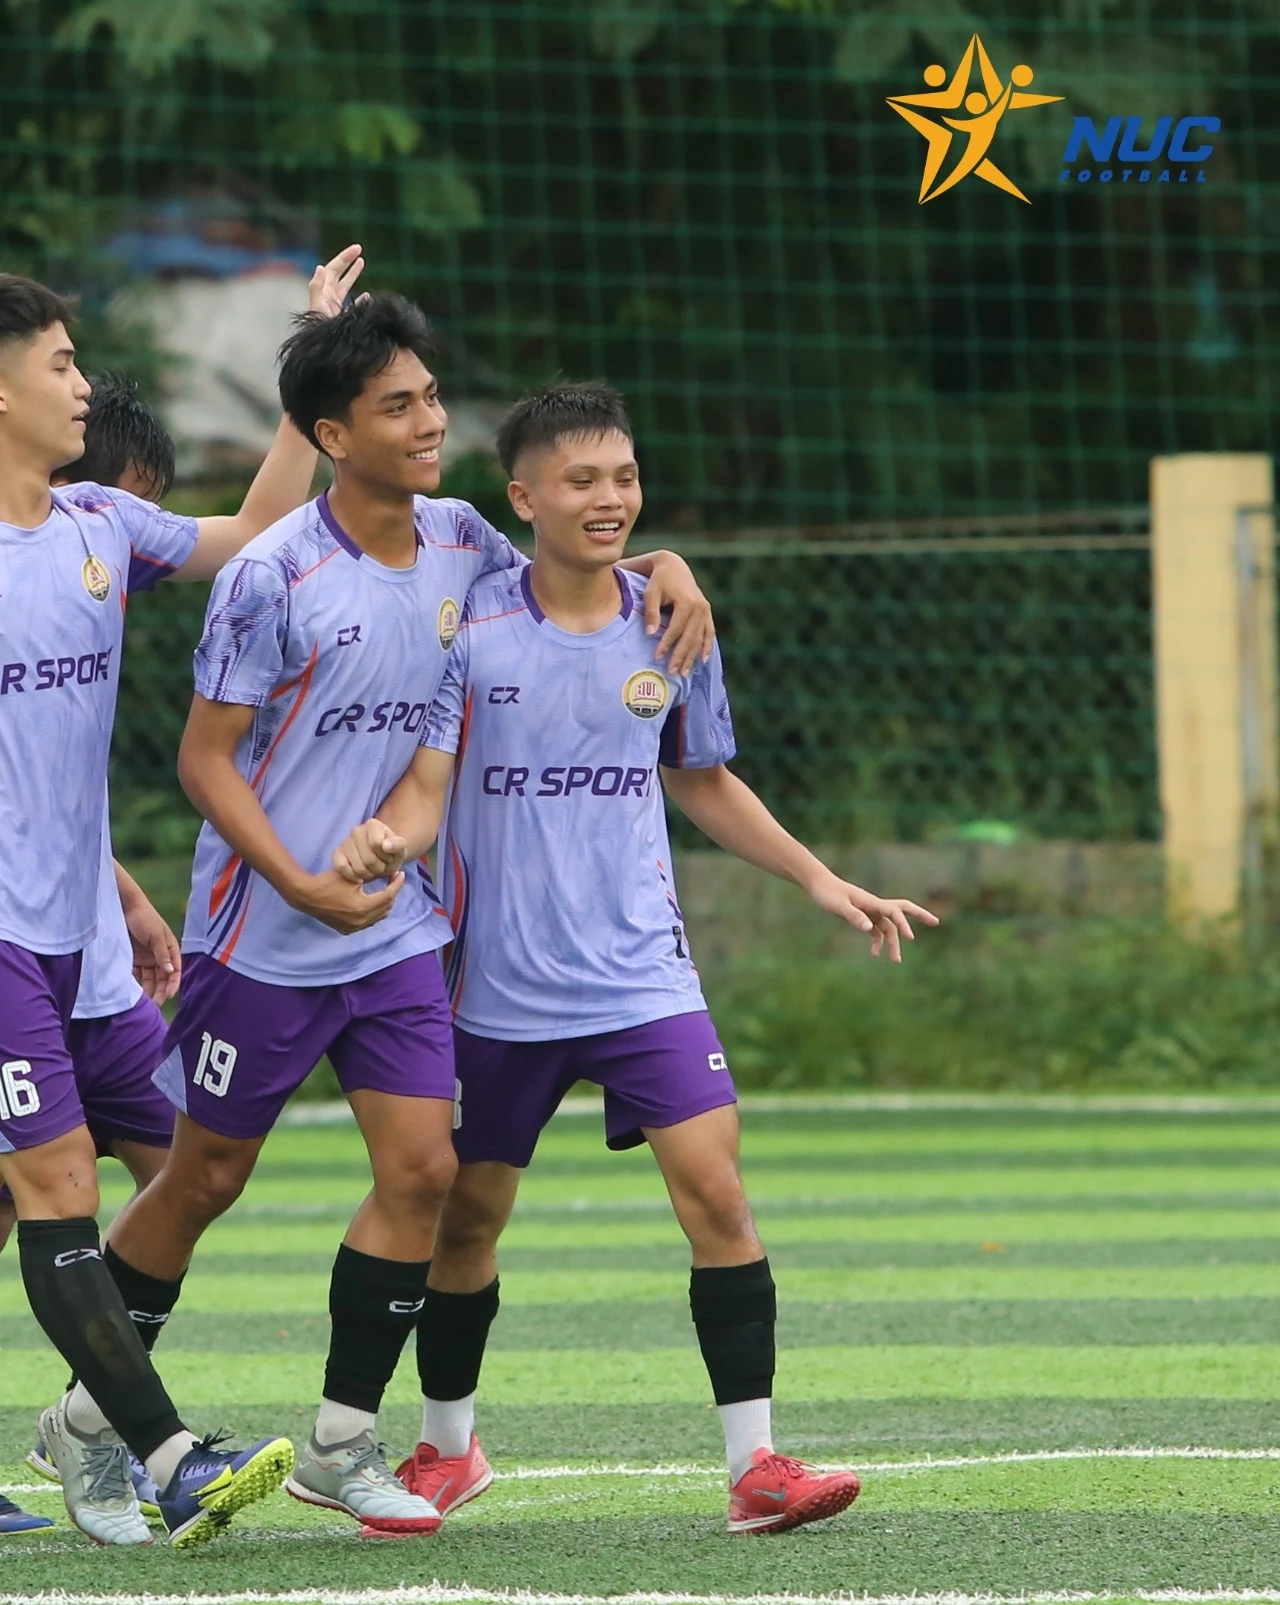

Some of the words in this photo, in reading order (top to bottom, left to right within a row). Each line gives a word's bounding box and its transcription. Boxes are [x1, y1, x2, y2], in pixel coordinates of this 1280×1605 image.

[315, 703, 366, 737] CR
[366, 700, 431, 733] SPO
[483, 766, 530, 797] CR
[193, 1031, 238, 1098] 19
